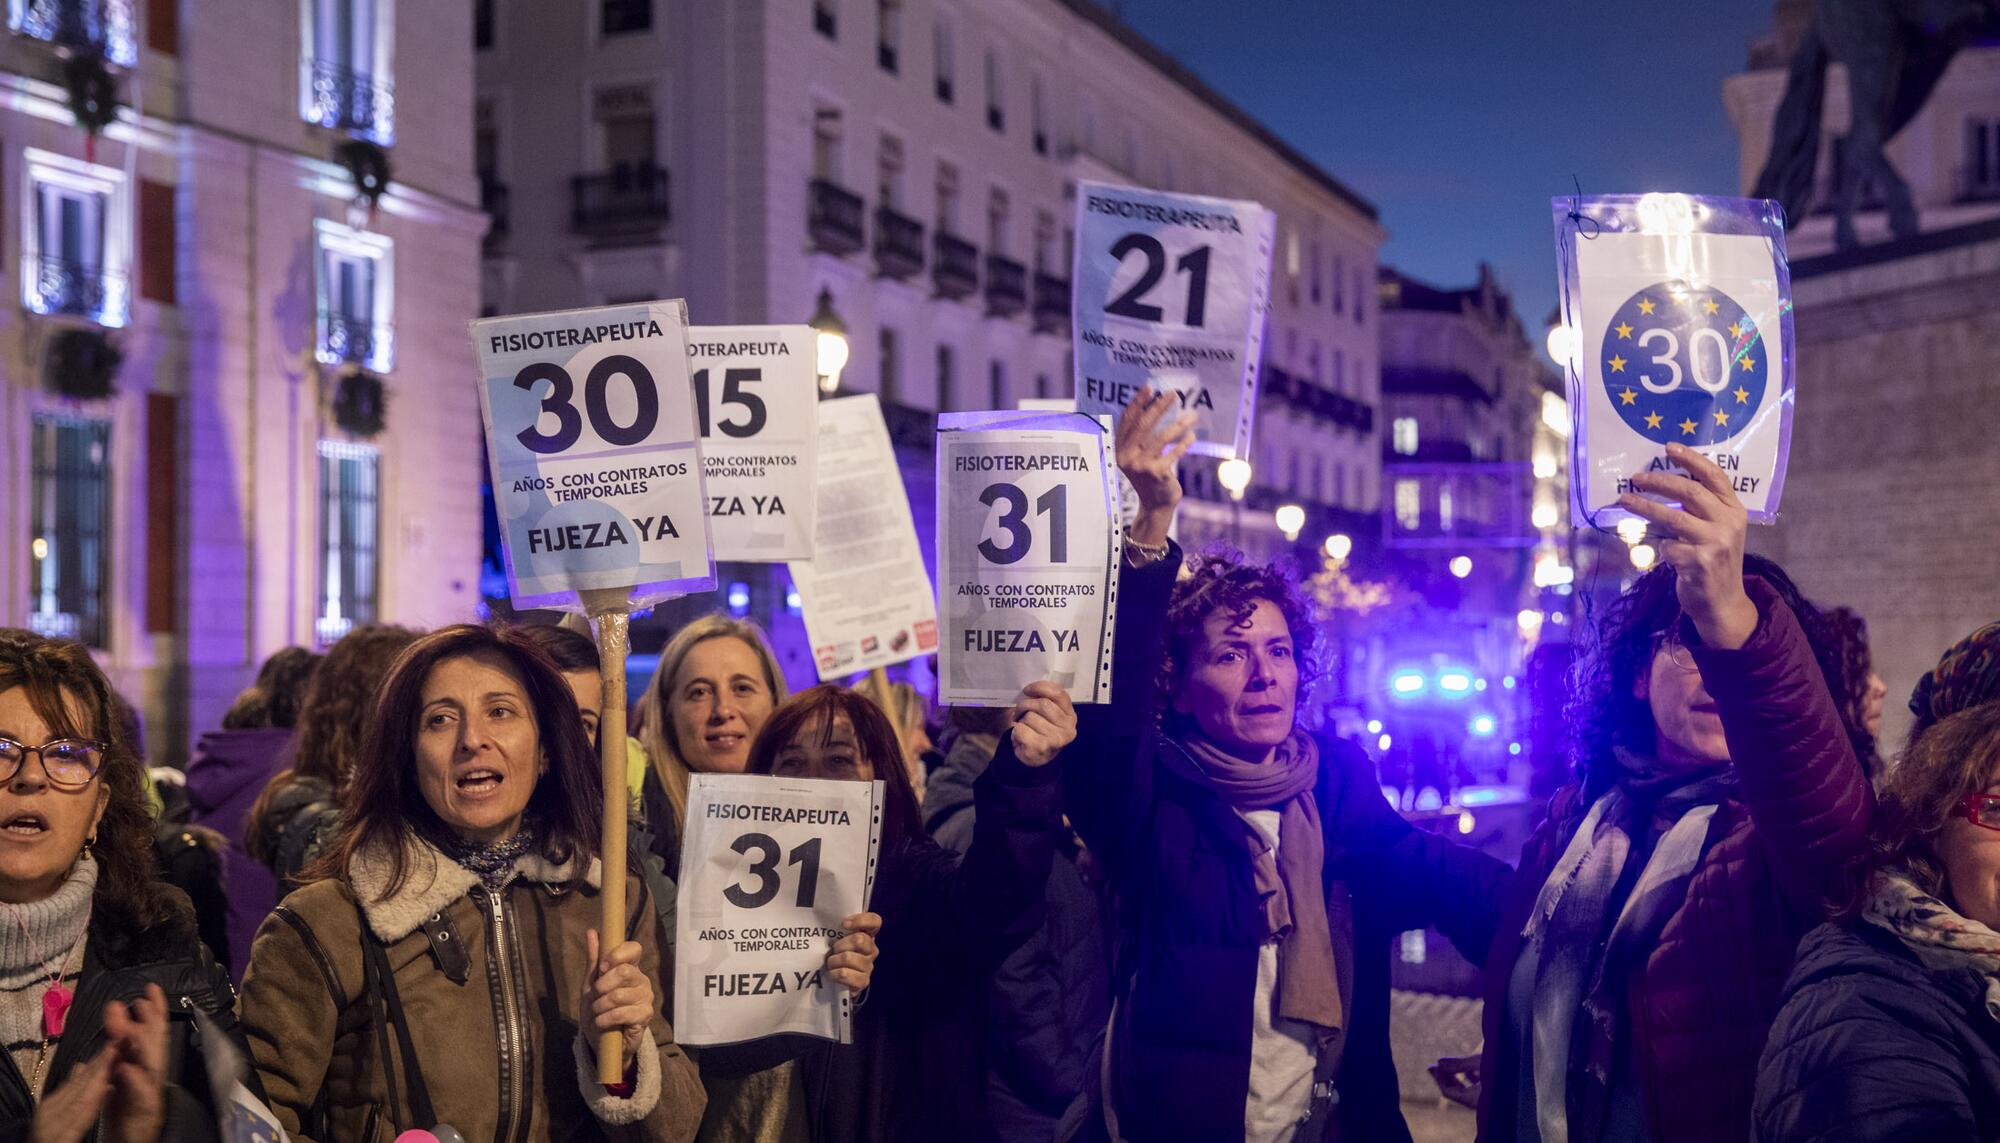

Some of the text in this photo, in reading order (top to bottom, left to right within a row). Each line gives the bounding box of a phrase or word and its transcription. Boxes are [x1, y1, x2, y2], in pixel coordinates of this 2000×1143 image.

[1087, 194, 1243, 235] FISIOTERAPEUTA
[1103, 233, 1211, 329] 21
[491, 320, 663, 354] FISIOTERAPEUTA
[1118, 340, 1150, 355] CON
[689, 342, 790, 357] OTERAPEUTA
[1638, 327, 1730, 395] 30
[513, 354, 659, 454] 30
[693, 367, 767, 438] 15
[1175, 388, 1213, 411] YA
[728, 455, 797, 466] CONTRATOS
[956, 455, 1089, 472] FISIOTERAPEUTA
[1717, 454, 1739, 470] EN
[512, 463, 687, 493] AÑOS CON CONTRATOS
[705, 467, 766, 477] MPORALES
[555, 481, 648, 502] TEMPORALES
[751, 495, 786, 515] YA
[528, 515, 680, 554] FIJEZA YA
[977, 482, 1067, 565] 31
[958, 582, 1095, 595] AÑOS CON CONTRATOS
[989, 597, 1067, 608] TEMPORALES
[964, 630, 1046, 652] FIJEZA
[1051, 630, 1080, 652] YA
[706, 803, 850, 826] FISIOTERAPEUTA
[722, 832, 822, 909] 31
[699, 927, 844, 940] AÑOS CON CONTRATOS
[734, 940, 810, 952] TEMPORALES
[704, 970, 823, 997] FIJEZA YA
